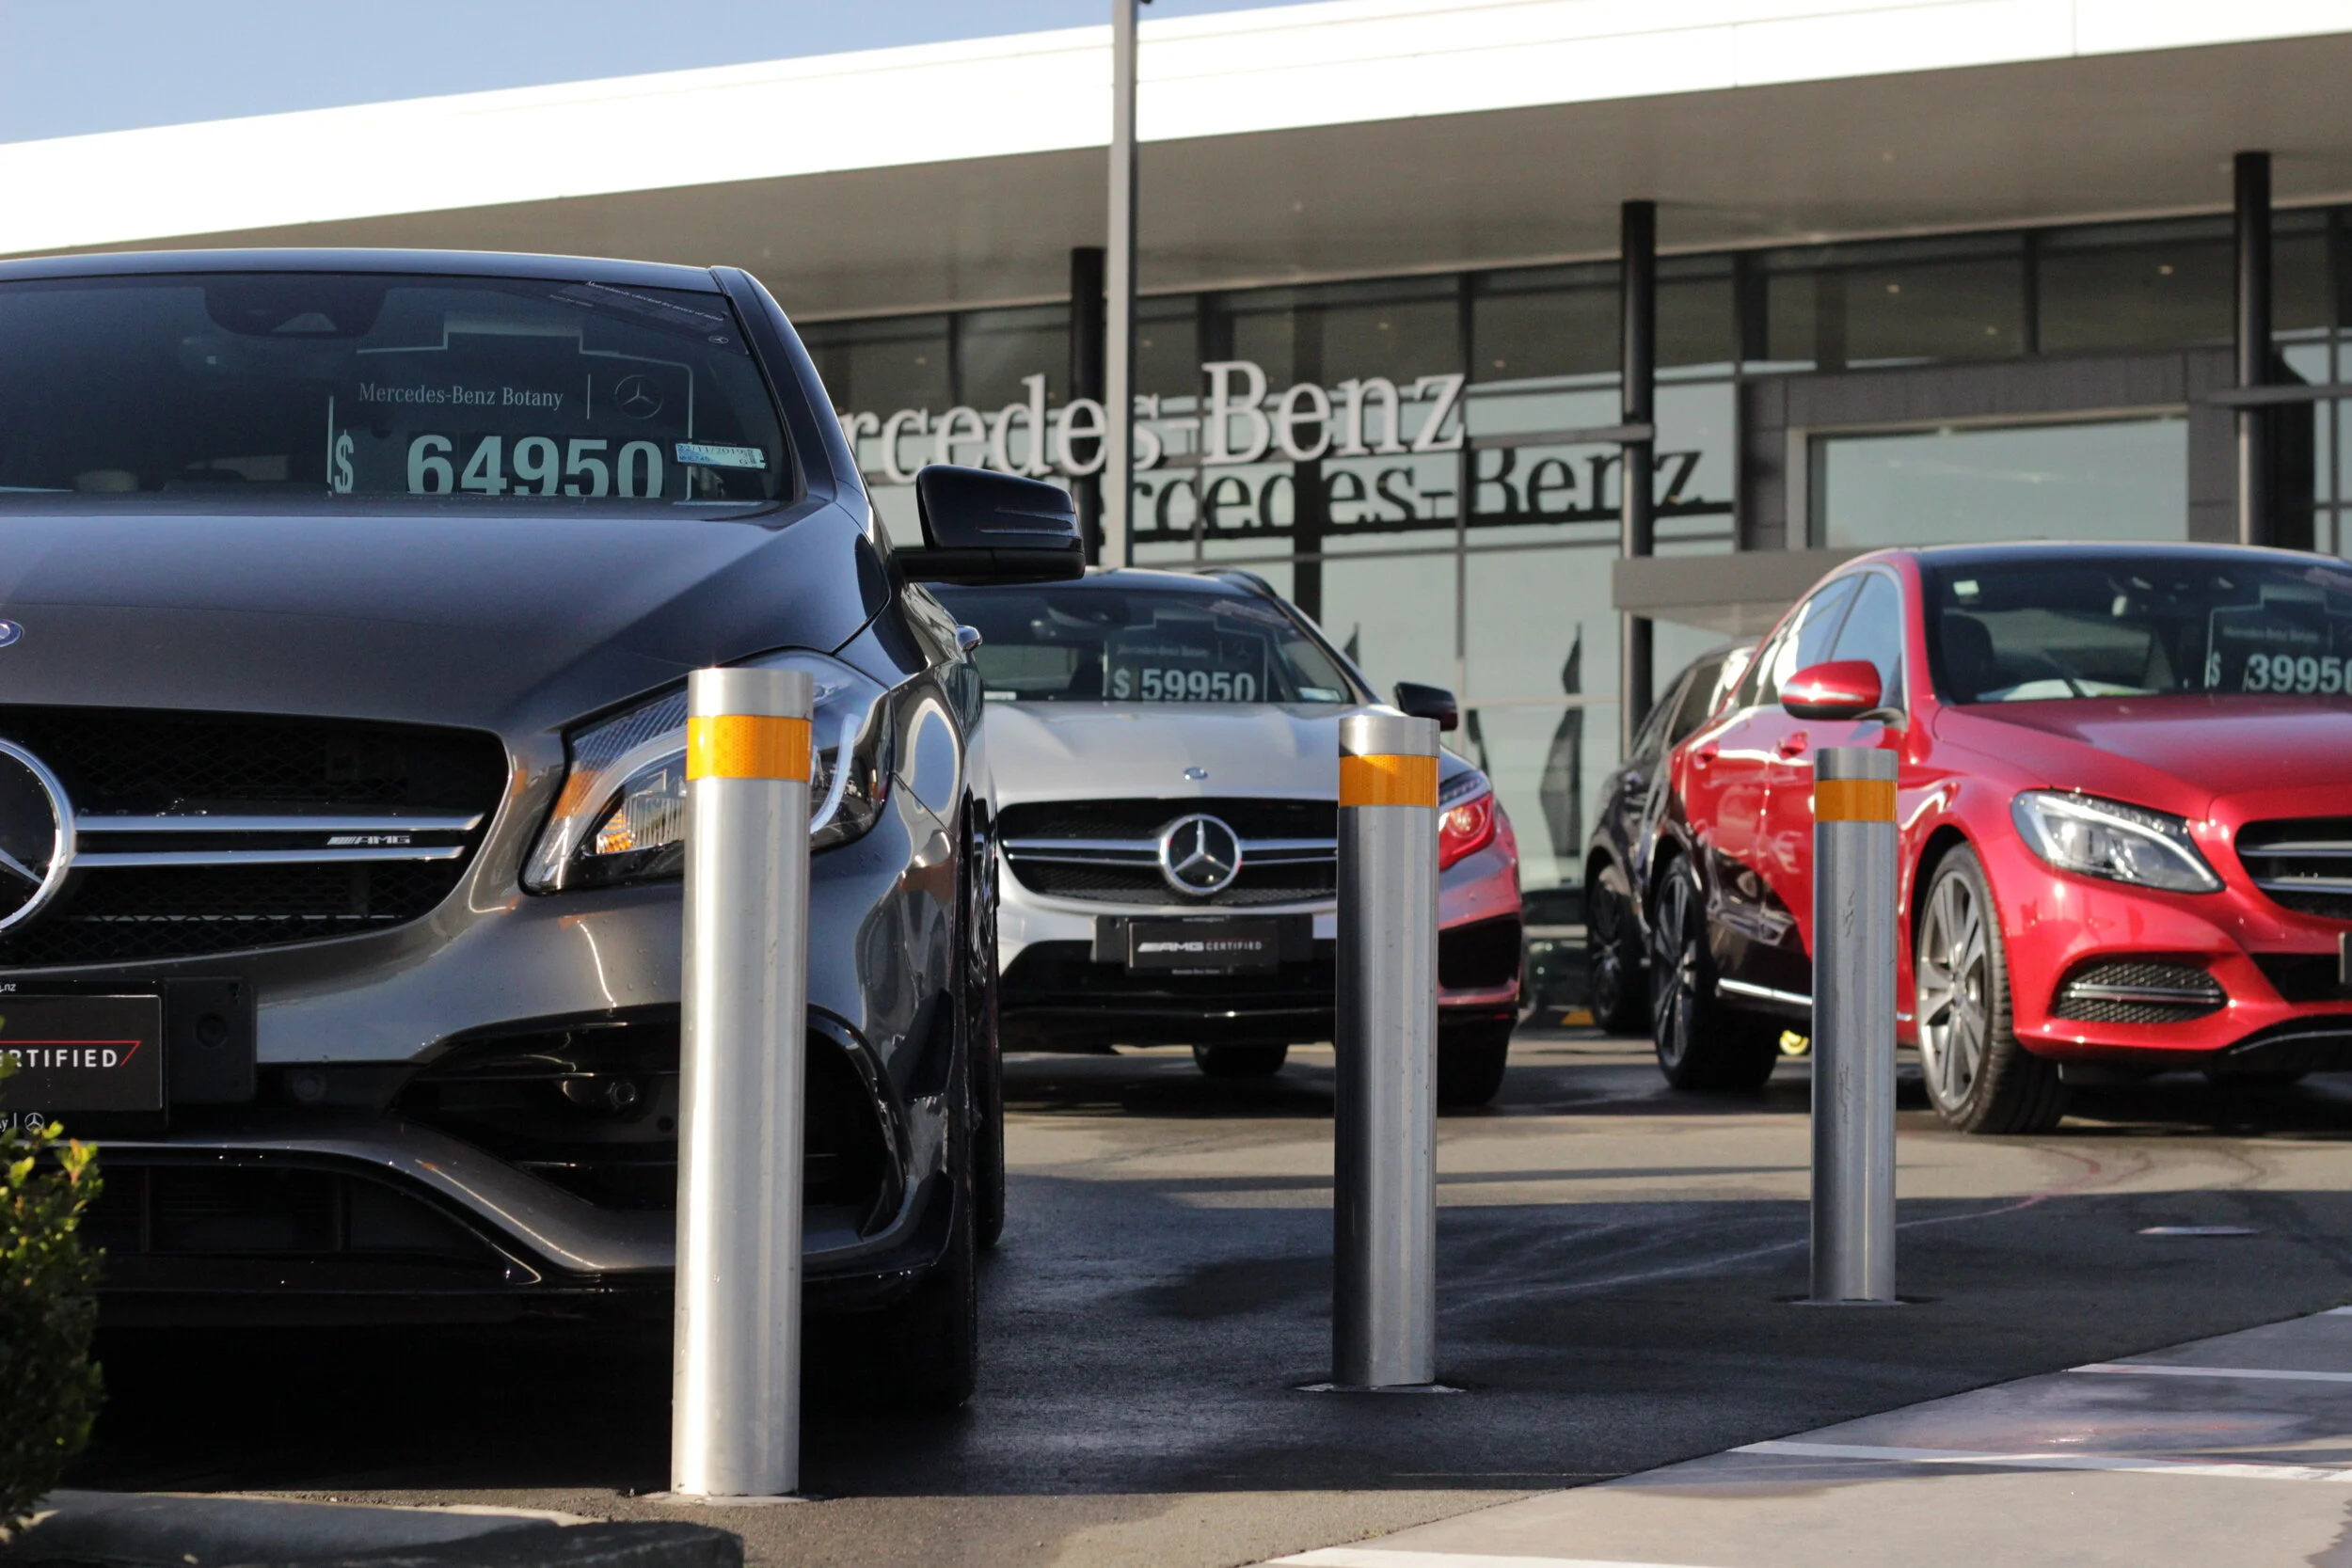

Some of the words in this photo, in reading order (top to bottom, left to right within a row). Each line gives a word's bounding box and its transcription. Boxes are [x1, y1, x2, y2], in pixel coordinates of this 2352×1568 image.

[358, 383, 496, 405] Mercedes-Benz
[502, 388, 564, 411] Botany
[334, 429, 354, 494] $
[407, 434, 663, 499] 64950
[1114, 667, 1131, 700] $
[1141, 668, 1256, 702] 59950
[354, 834, 411, 845] AMG
[1158, 942, 1205, 953] AMG
[1205, 942, 1263, 951] CERTIFIED
